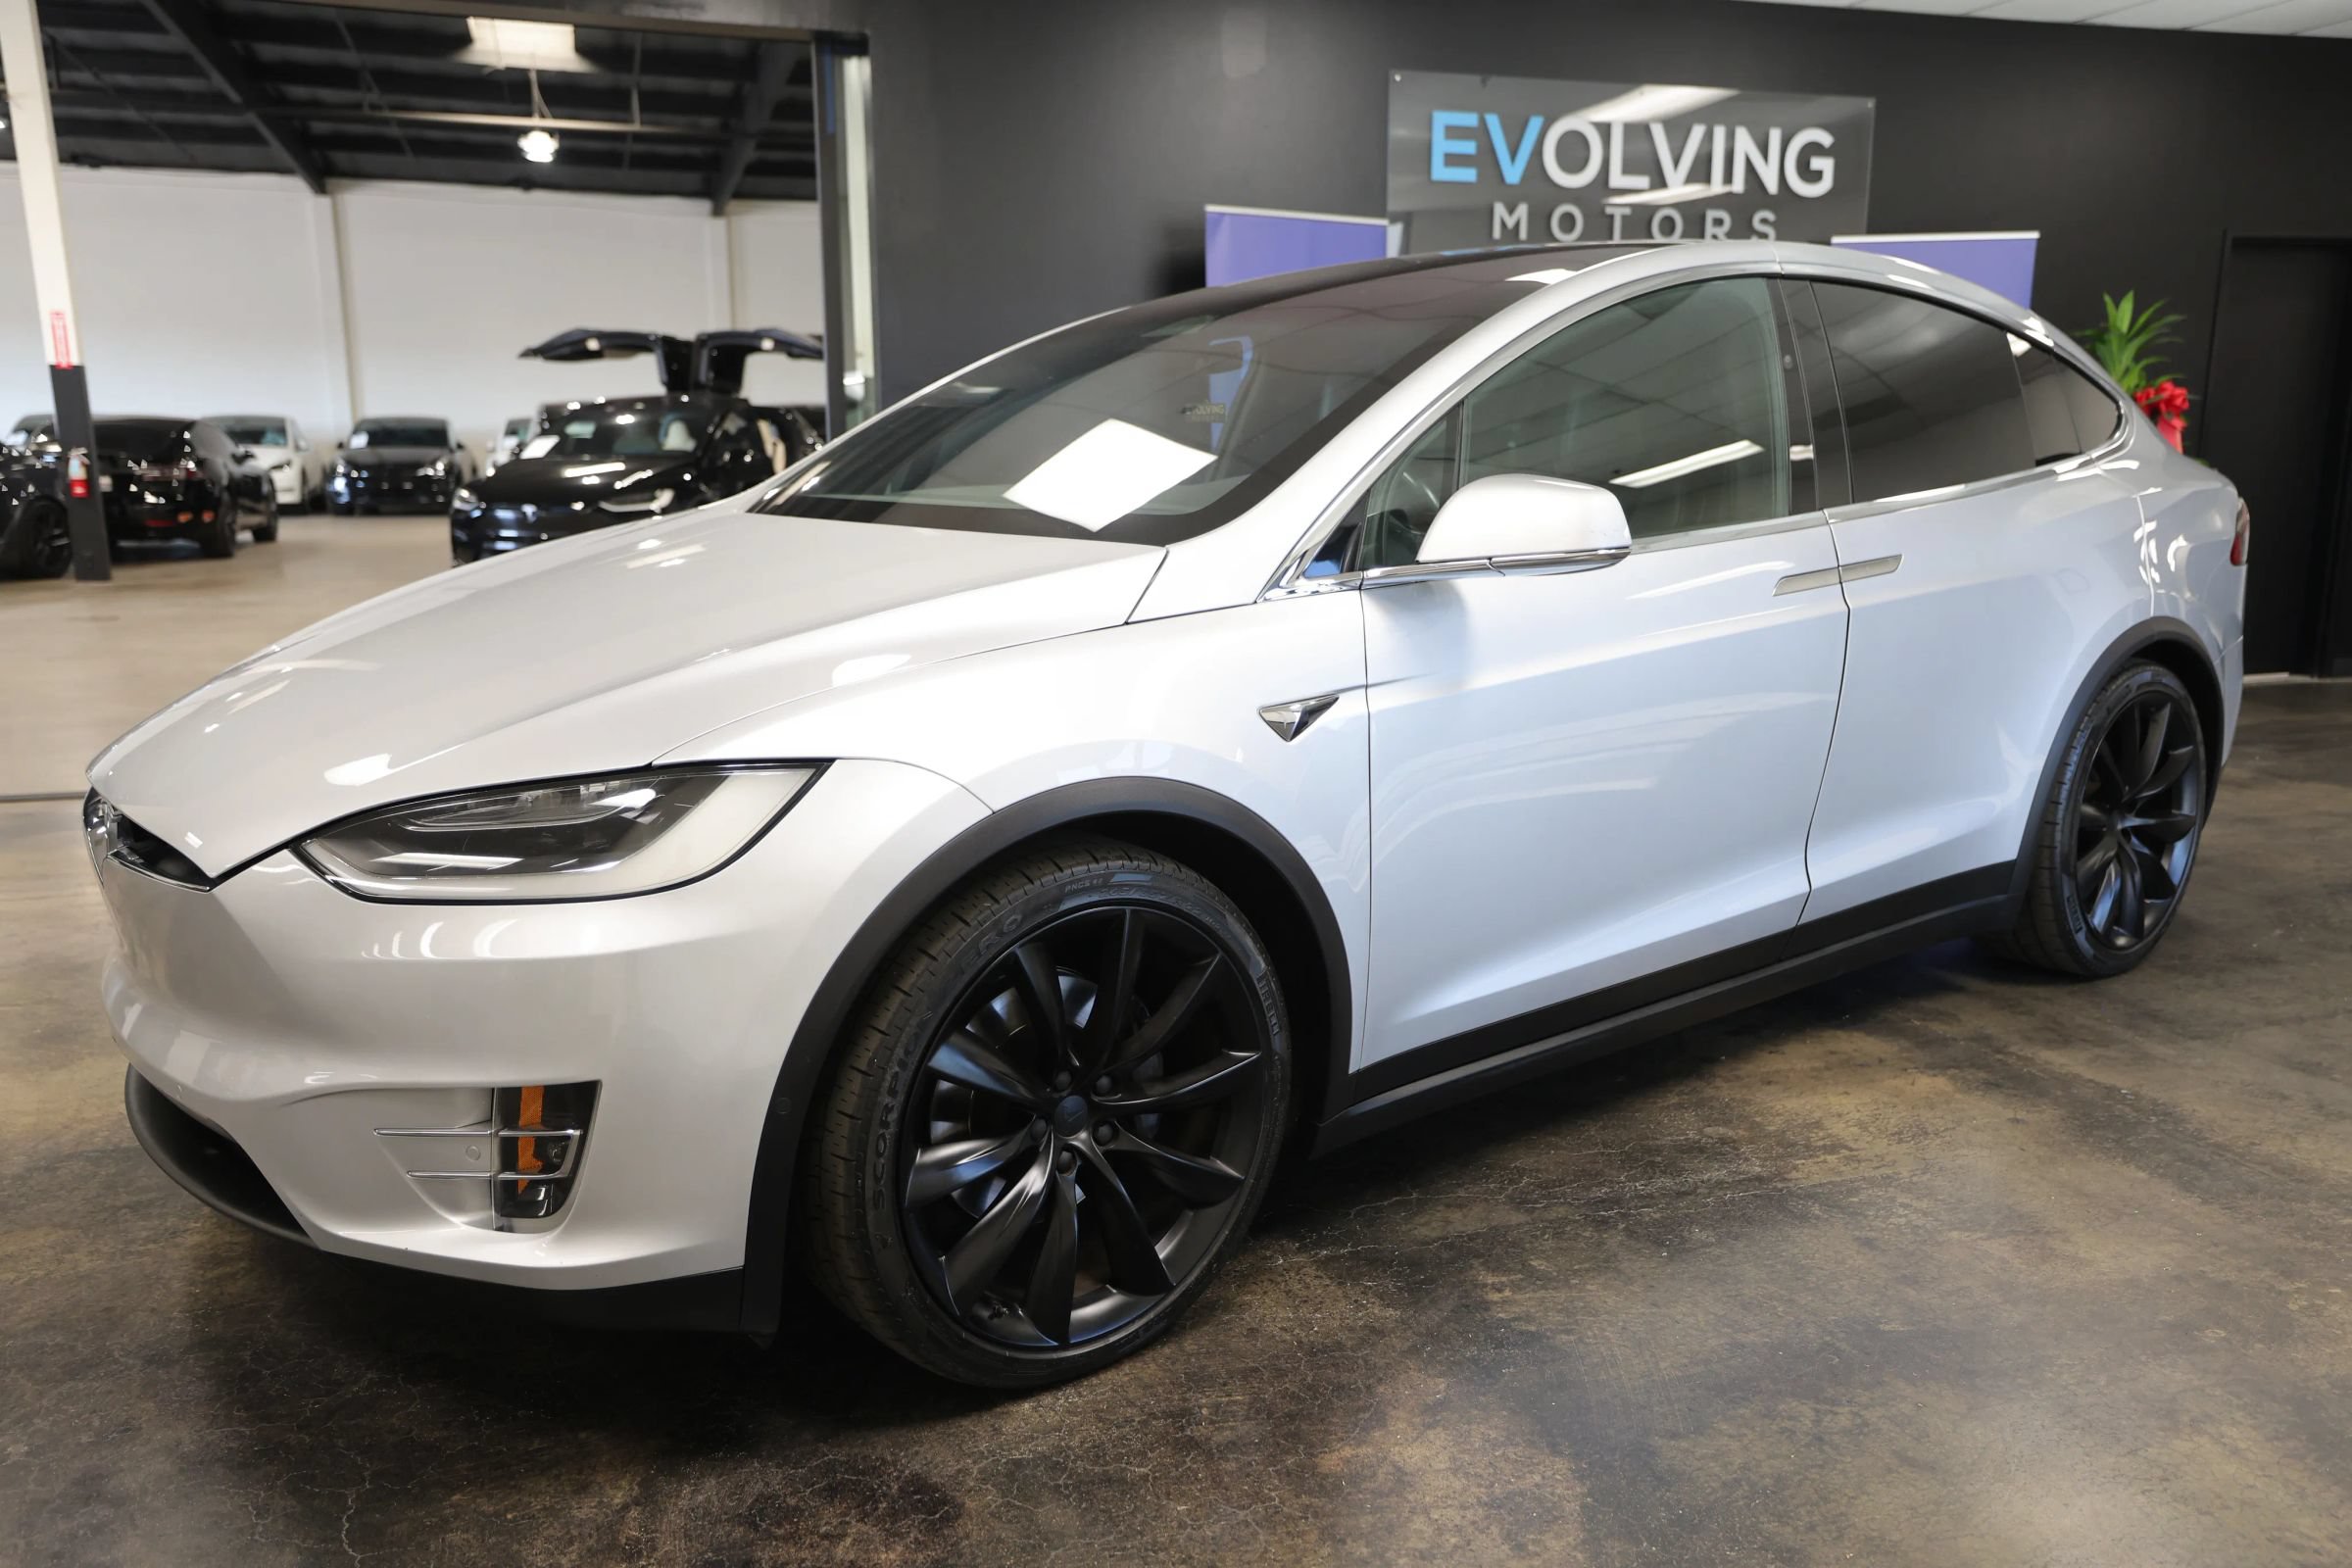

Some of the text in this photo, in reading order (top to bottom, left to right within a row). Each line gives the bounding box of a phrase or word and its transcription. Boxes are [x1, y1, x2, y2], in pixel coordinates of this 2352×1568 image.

[1430, 109, 1837, 199] EVOLVING
[1492, 201, 1778, 243] MOTORS
[1184, 404, 1224, 415] OLVING
